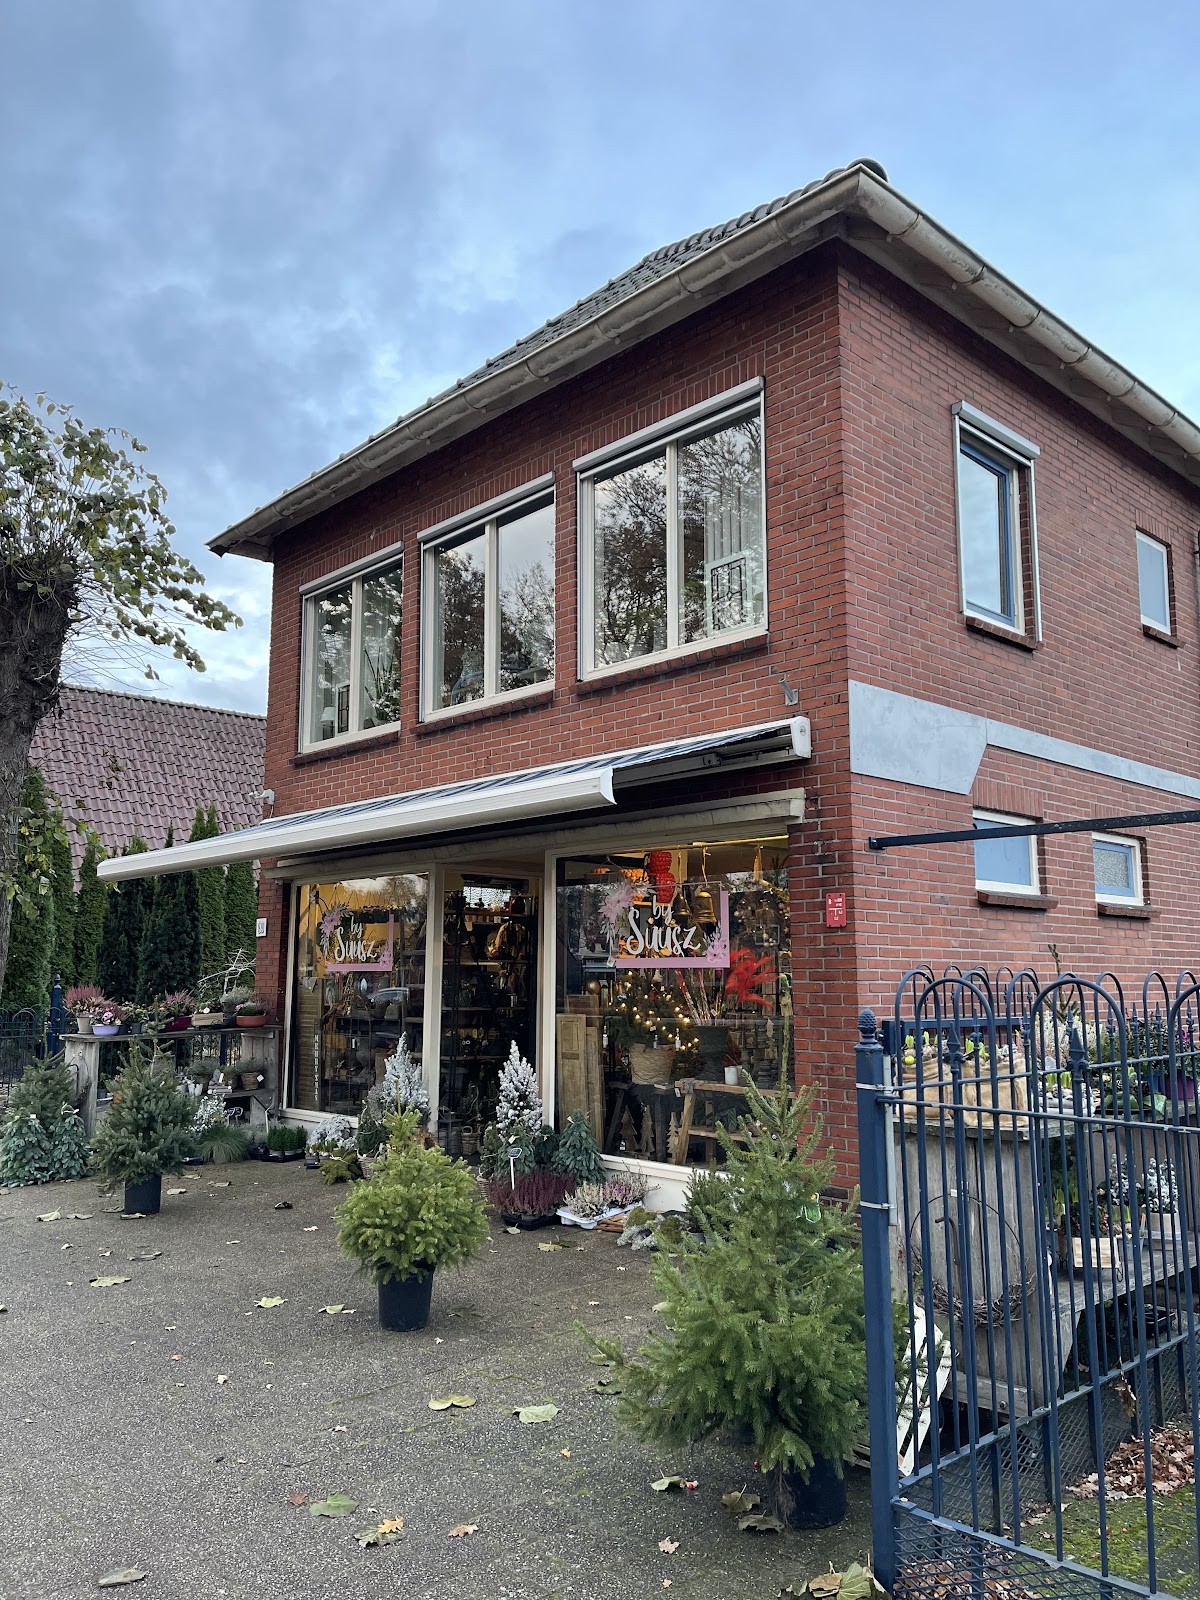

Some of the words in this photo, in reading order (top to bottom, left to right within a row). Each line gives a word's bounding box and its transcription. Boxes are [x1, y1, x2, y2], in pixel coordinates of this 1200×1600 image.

[652, 894, 675, 926] by
[334, 926, 377, 961] Suusz
[350, 916, 363, 938] by
[626, 907, 701, 958] Suusz
